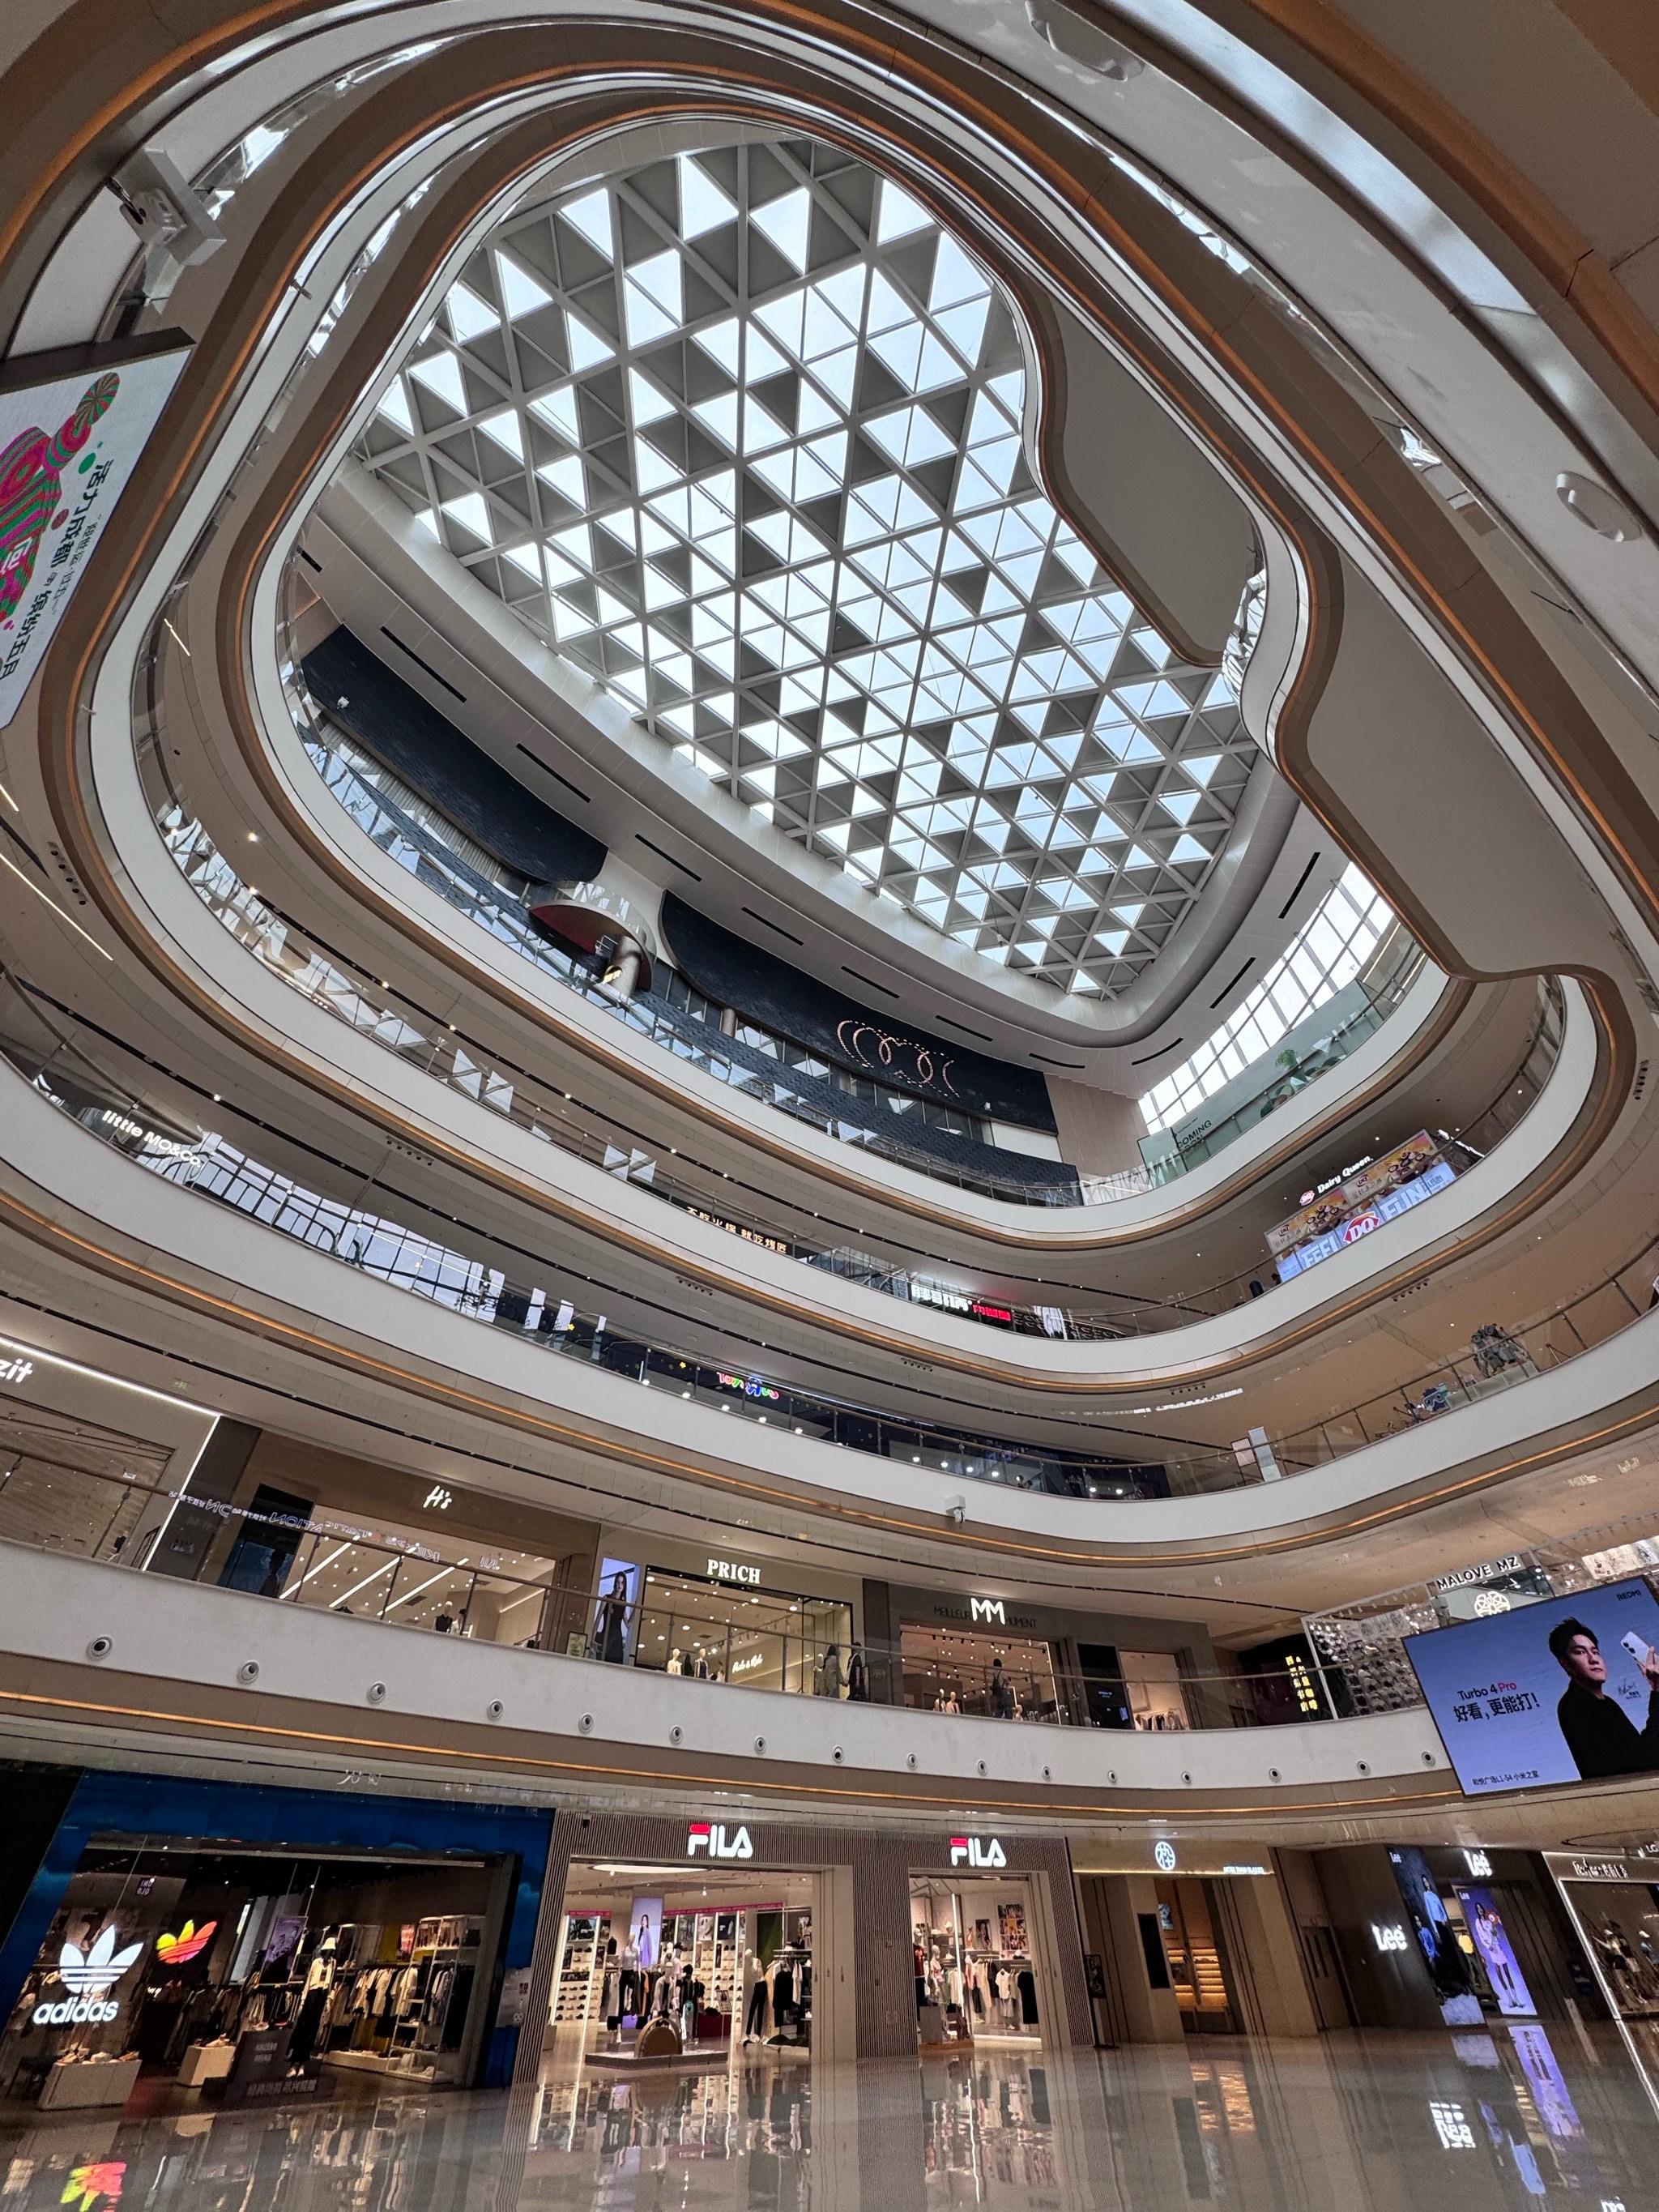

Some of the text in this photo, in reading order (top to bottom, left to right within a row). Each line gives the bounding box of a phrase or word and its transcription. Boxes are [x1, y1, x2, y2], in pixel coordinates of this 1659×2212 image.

[51, 459, 114, 568] 活力成都
[0, 591, 52, 679] 缤纷五月
[102, 1110, 202, 1168] little MO&Co.
[1317, 1175, 1341, 1194] Dairy
[707, 1559, 761, 1584] PRICH
[1436, 1556, 1521, 1590] MALOVE MZ
[1616, 1589, 1642, 1601] REDMI
[970, 1598, 1005, 1625] MM
[1457, 1682, 1517, 1701] Turbo 4 Pro
[688, 1824, 753, 1859] FILA
[950, 1838, 1007, 1867] FILA
[1389, 1851, 1401, 1863] Lee
[1463, 1849, 1493, 1877] Lee
[1459, 1892, 1470, 1900] Lee
[1371, 1924, 1408, 1951] Lee
[32, 1996, 119, 2024] adidas
